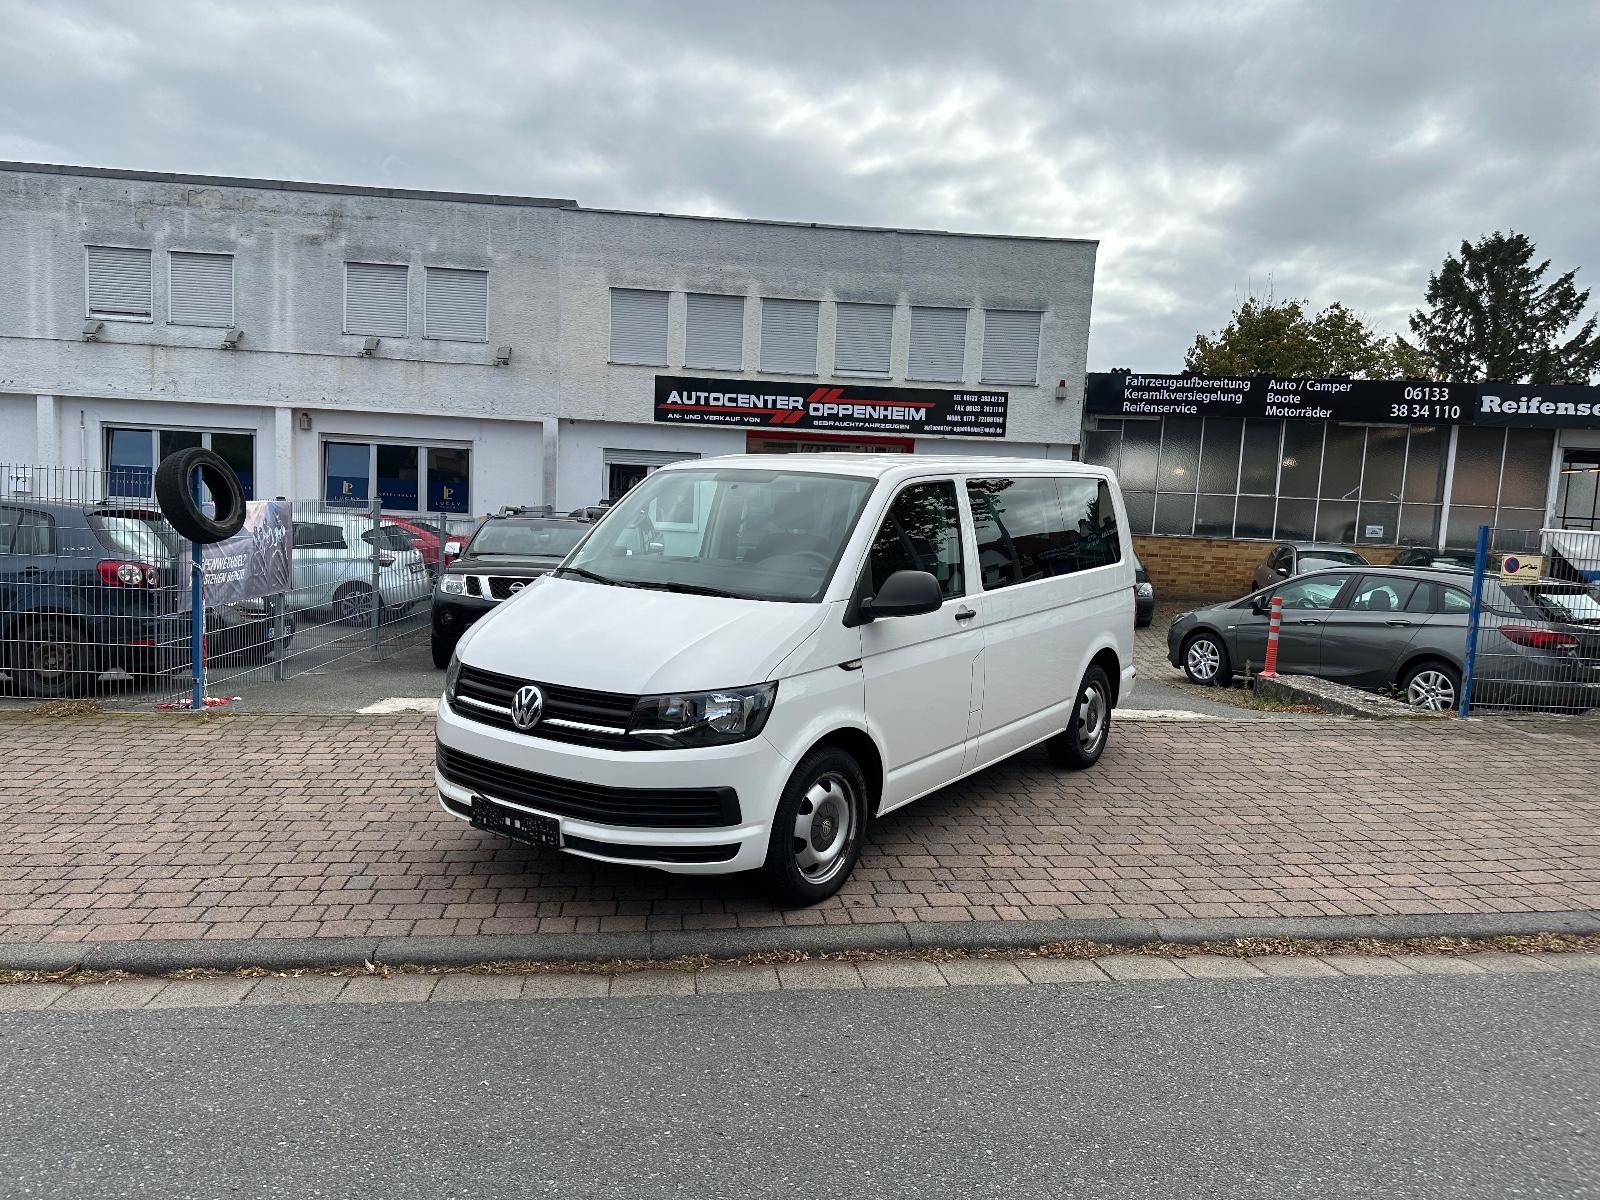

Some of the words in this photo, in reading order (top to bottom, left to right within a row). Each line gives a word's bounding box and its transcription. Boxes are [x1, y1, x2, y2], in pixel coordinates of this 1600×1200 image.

[1125, 375, 1250, 391] Fahrzeugaufbereitung
[1268, 379, 1297, 390] Auto
[1298, 380, 1305, 391] /
[1306, 381, 1353, 394] Camper
[666, 390, 804, 410] AUTOCENTER
[1124, 388, 1243, 404] Keramikversiegelung
[1266, 393, 1301, 404] Boote
[1404, 387, 1449, 401] 06133
[808, 403, 926, 421] OPPENHEIM
[1122, 401, 1198, 414] Reifenservice
[1265, 405, 1333, 418] Motorräder
[1390, 404, 1408, 417] 38
[1411, 404, 1430, 418] 34
[1434, 405, 1461, 419] 110
[703, 414, 741, 422] VERKAUF
[813, 420, 910, 430] GEBRAUCHTFAHRZEUGEN
